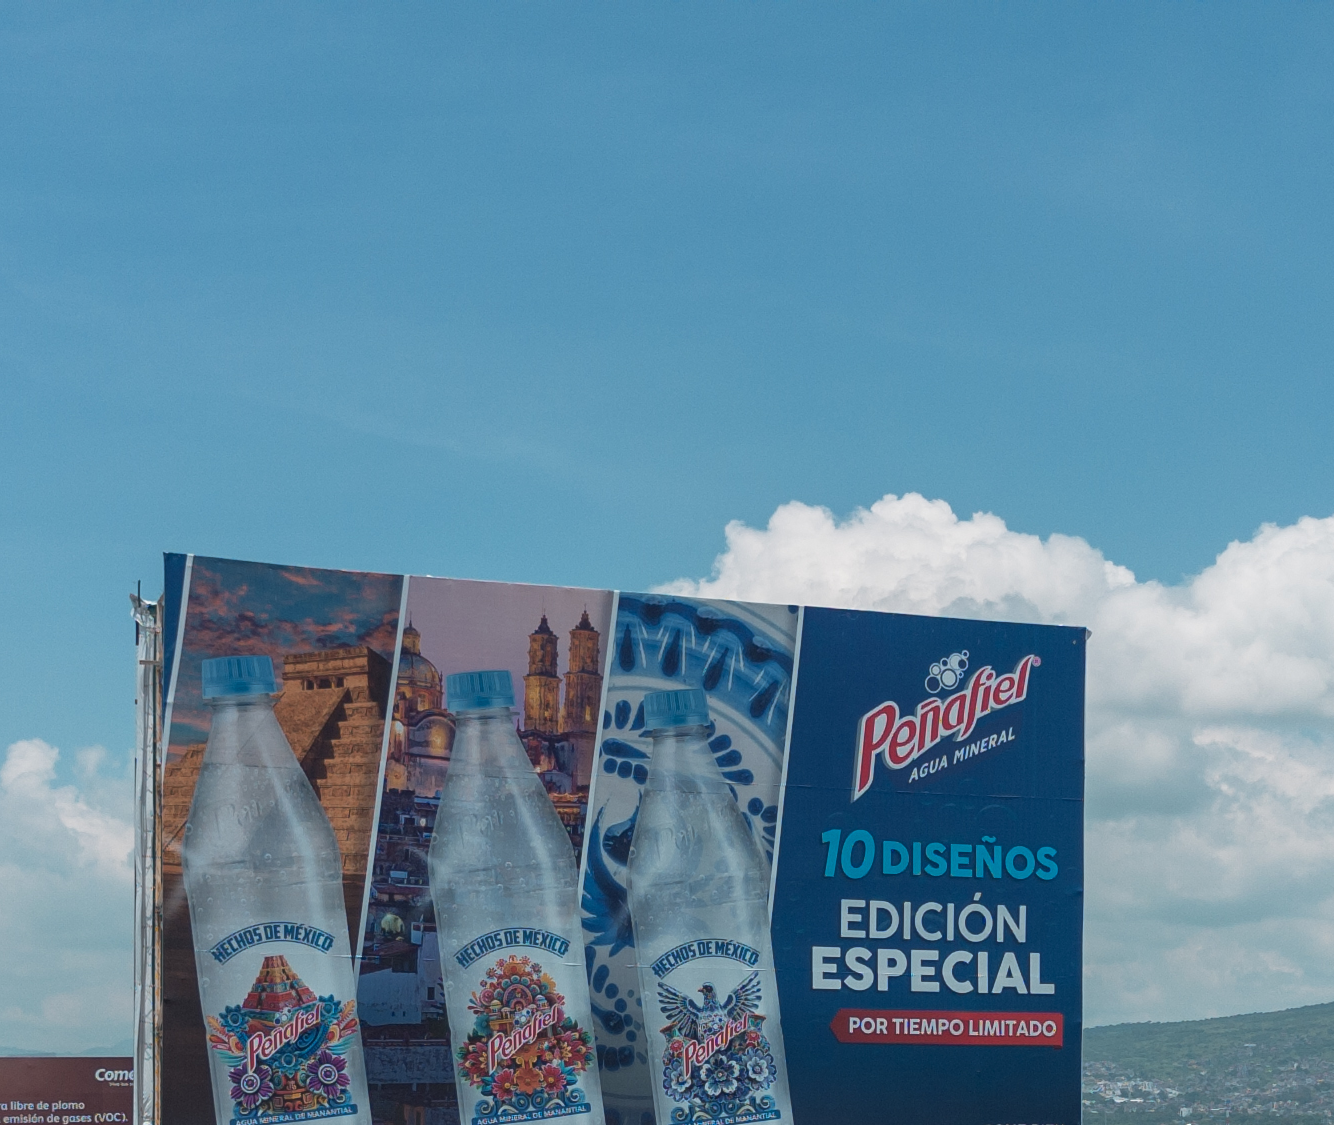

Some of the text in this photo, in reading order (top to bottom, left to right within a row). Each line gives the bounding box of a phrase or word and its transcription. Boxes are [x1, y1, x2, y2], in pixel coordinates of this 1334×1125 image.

[851, 654, 1035, 804] Peñafiel
[908, 727, 1016, 783] AGUA MINERAL
[821, 828, 1059, 881] 10 DISEÑOS
[840, 892, 1027, 944] EDICIÓN
[211, 922, 335, 964] HECHOS DE MÉXICO
[455, 927, 570, 968] HECHOS DE MÉXICO
[651, 938, 760, 979] HECHOS DE MÉXICO
[812, 946, 1056, 995] ESPECIAL
[248, 1003, 324, 1075] Peñafiel
[488, 1003, 561, 1075] Peñafiel
[684, 1012, 749, 1079] Peñafiel
[848, 1016, 1057, 1037] POR TIEMPO LIMITADO
[3, 1113, 44, 1124] emisión
[47, 1113, 60, 1123] de
[62, 1114, 92, 1125] gases
[94, 1112, 129, 1124] (VOC).
[10, 1101, 35, 1111] libre
[36, 1101, 49, 1110] de
[52, 1101, 85, 1112] plomo
[259, 1115, 295, 1125] MINERAL
[294, 1112, 306, 1121] DE
[307, 1106, 354, 1119] MANANTIAL
[477, 1118, 498, 1125] AGUA
